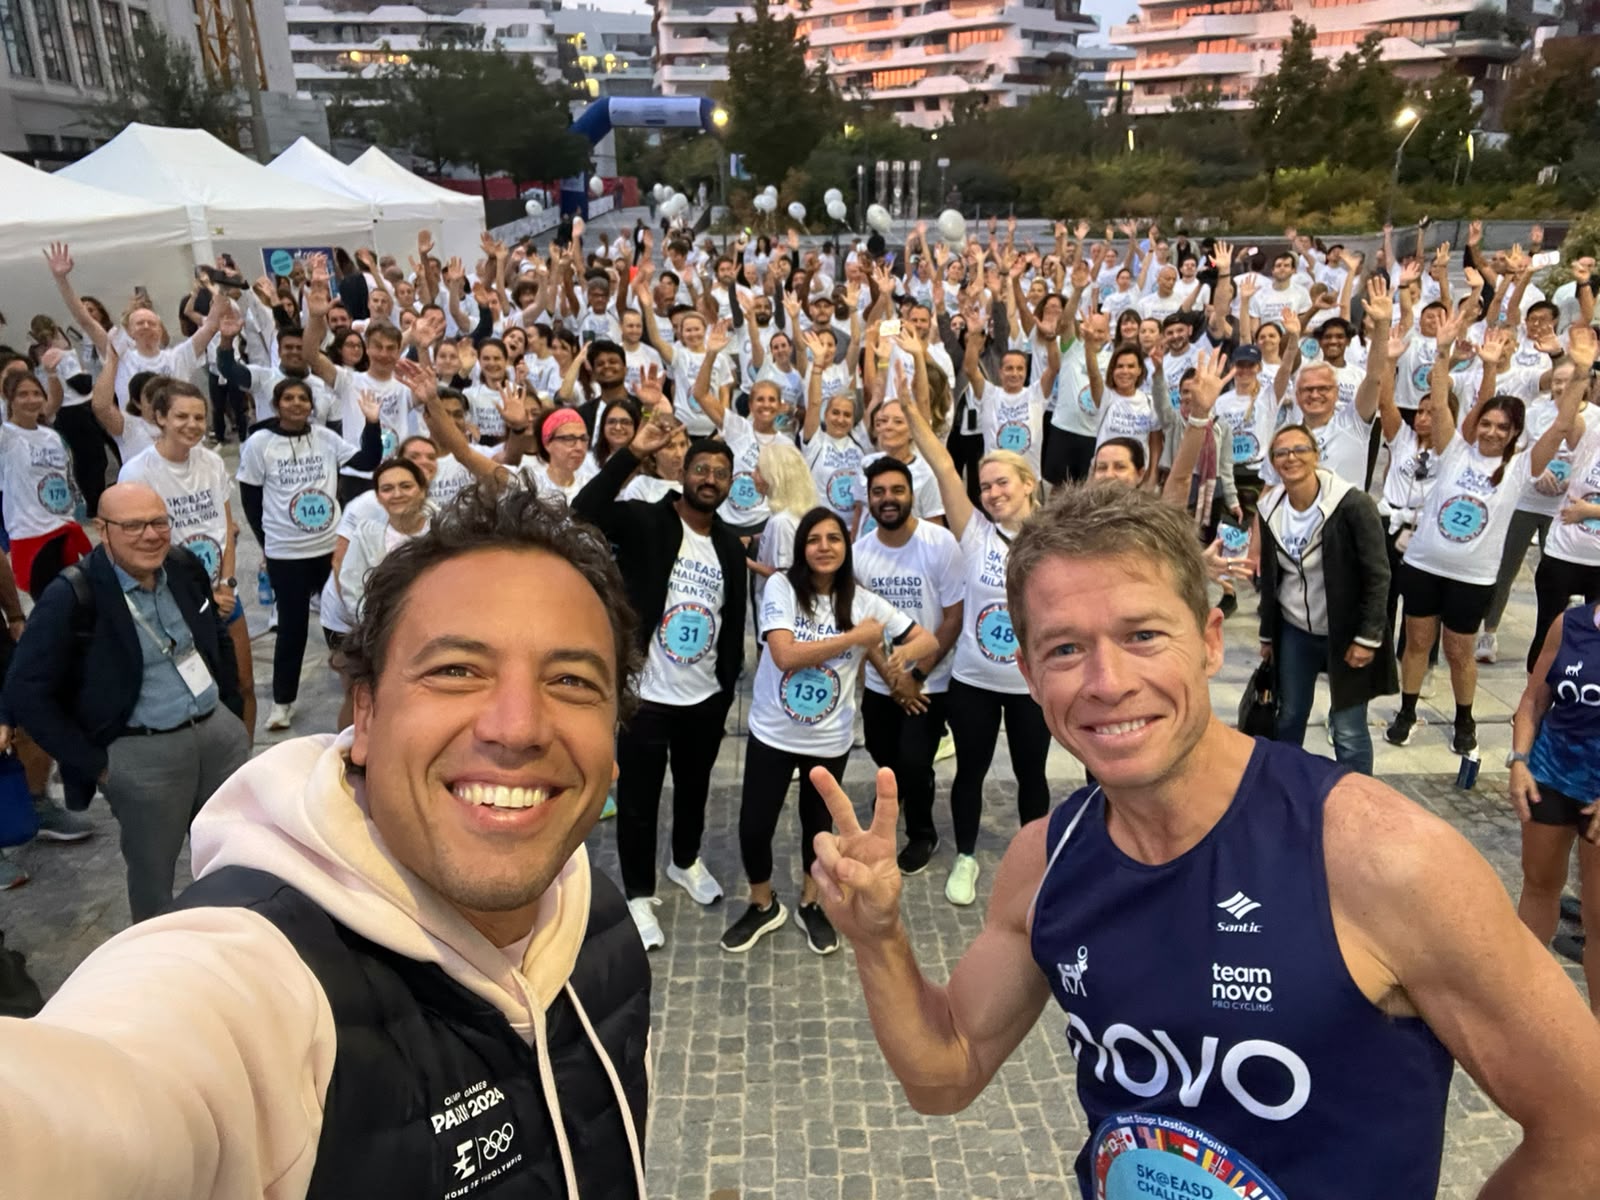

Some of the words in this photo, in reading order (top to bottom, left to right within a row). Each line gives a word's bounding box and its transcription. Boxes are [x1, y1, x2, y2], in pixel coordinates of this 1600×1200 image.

[1008, 434, 1020, 444] 71
[1585, 477, 1600, 489] MIL
[300, 504, 326, 518] 144
[1451, 511, 1473, 528] 22
[871, 576, 922, 588] 5K@EASD
[980, 574, 1005, 588] MILA
[679, 626, 699, 643] 31
[990, 625, 1015, 644] 48
[794, 683, 828, 704] 139
[1217, 922, 1264, 933] Santic
[1212, 962, 1272, 984] team
[1212, 983, 1273, 1003] novo
[1212, 1000, 1230, 1009] PRO
[1231, 1001, 1274, 1013] CYCLING
[1066, 1012, 1311, 1121] novo
[463, 1080, 488, 1098] GAMES
[468, 1087, 505, 1118] 2024
[1157, 1117, 1194, 1139] Lasting
[1194, 1129, 1229, 1157] Health
[1136, 1163, 1214, 1200] 5K@EASD
